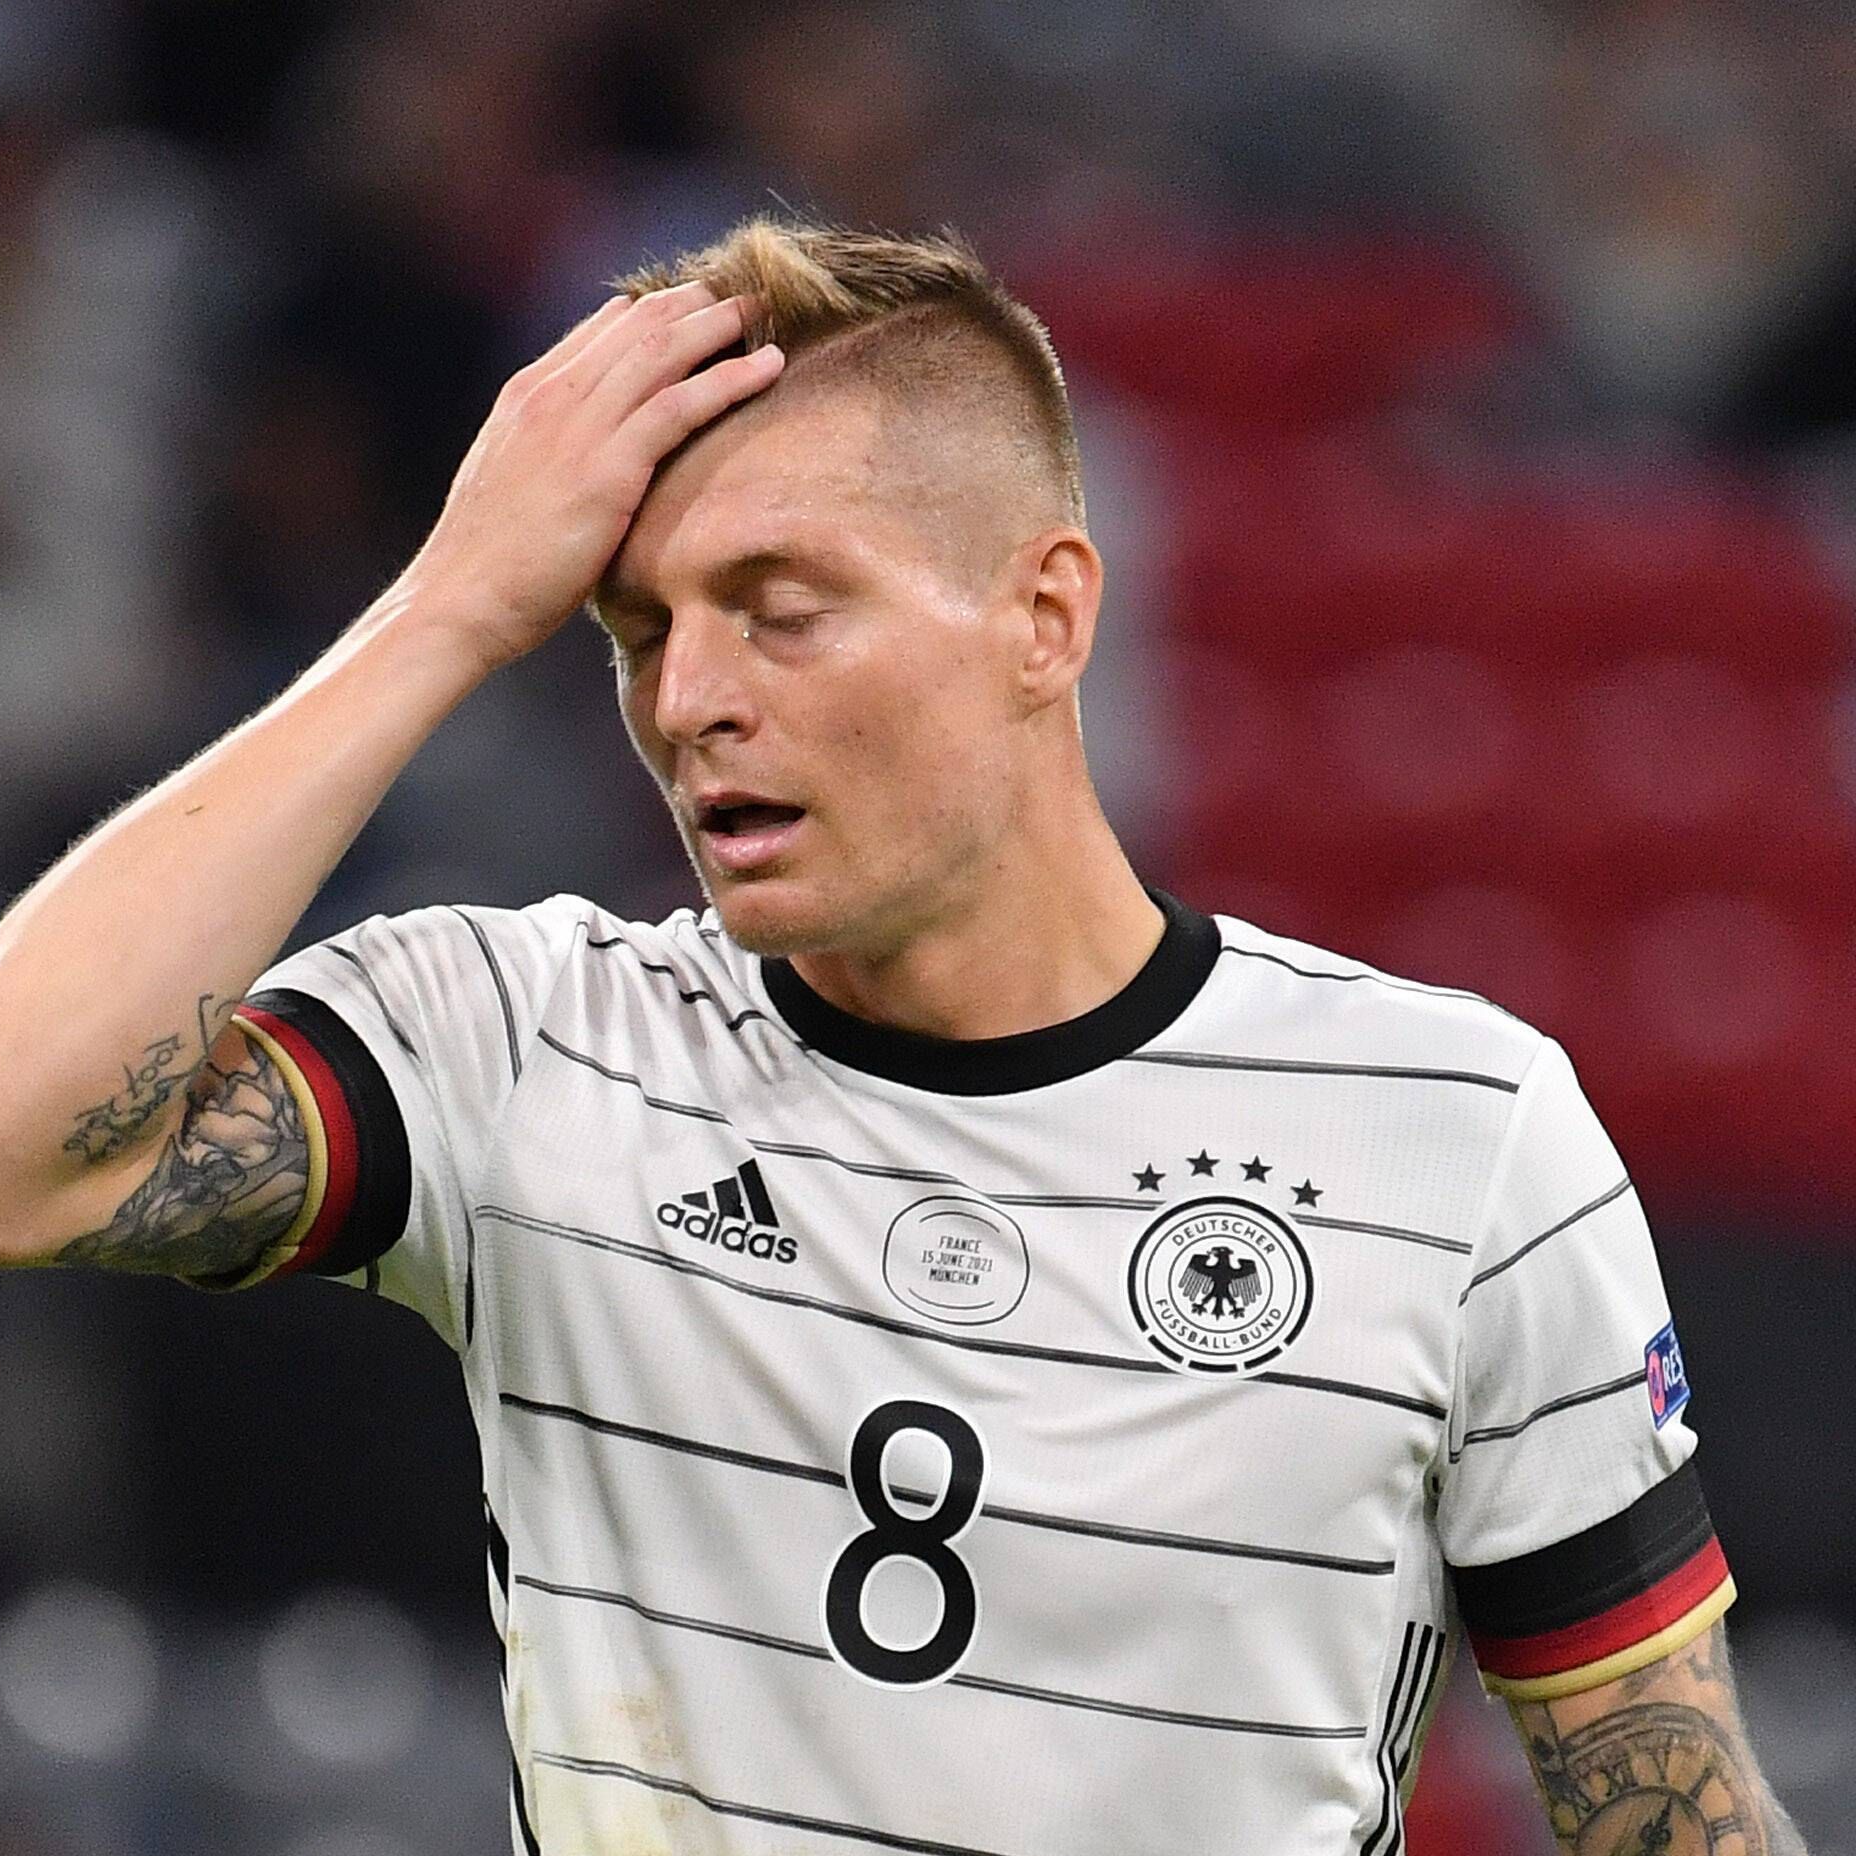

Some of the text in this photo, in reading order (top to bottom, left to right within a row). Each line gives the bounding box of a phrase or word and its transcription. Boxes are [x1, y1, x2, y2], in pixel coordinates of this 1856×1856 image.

[657, 1202, 798, 1264] adidas
[939, 1235, 982, 1254] FRANCE
[1172, 1219, 1276, 1255] DEUTSCHER
[921, 1249, 993, 1272] 15 JUNE 2021
[1155, 1298, 1282, 1349] FUSSBALL-BUND
[825, 1399, 985, 1684] 8
